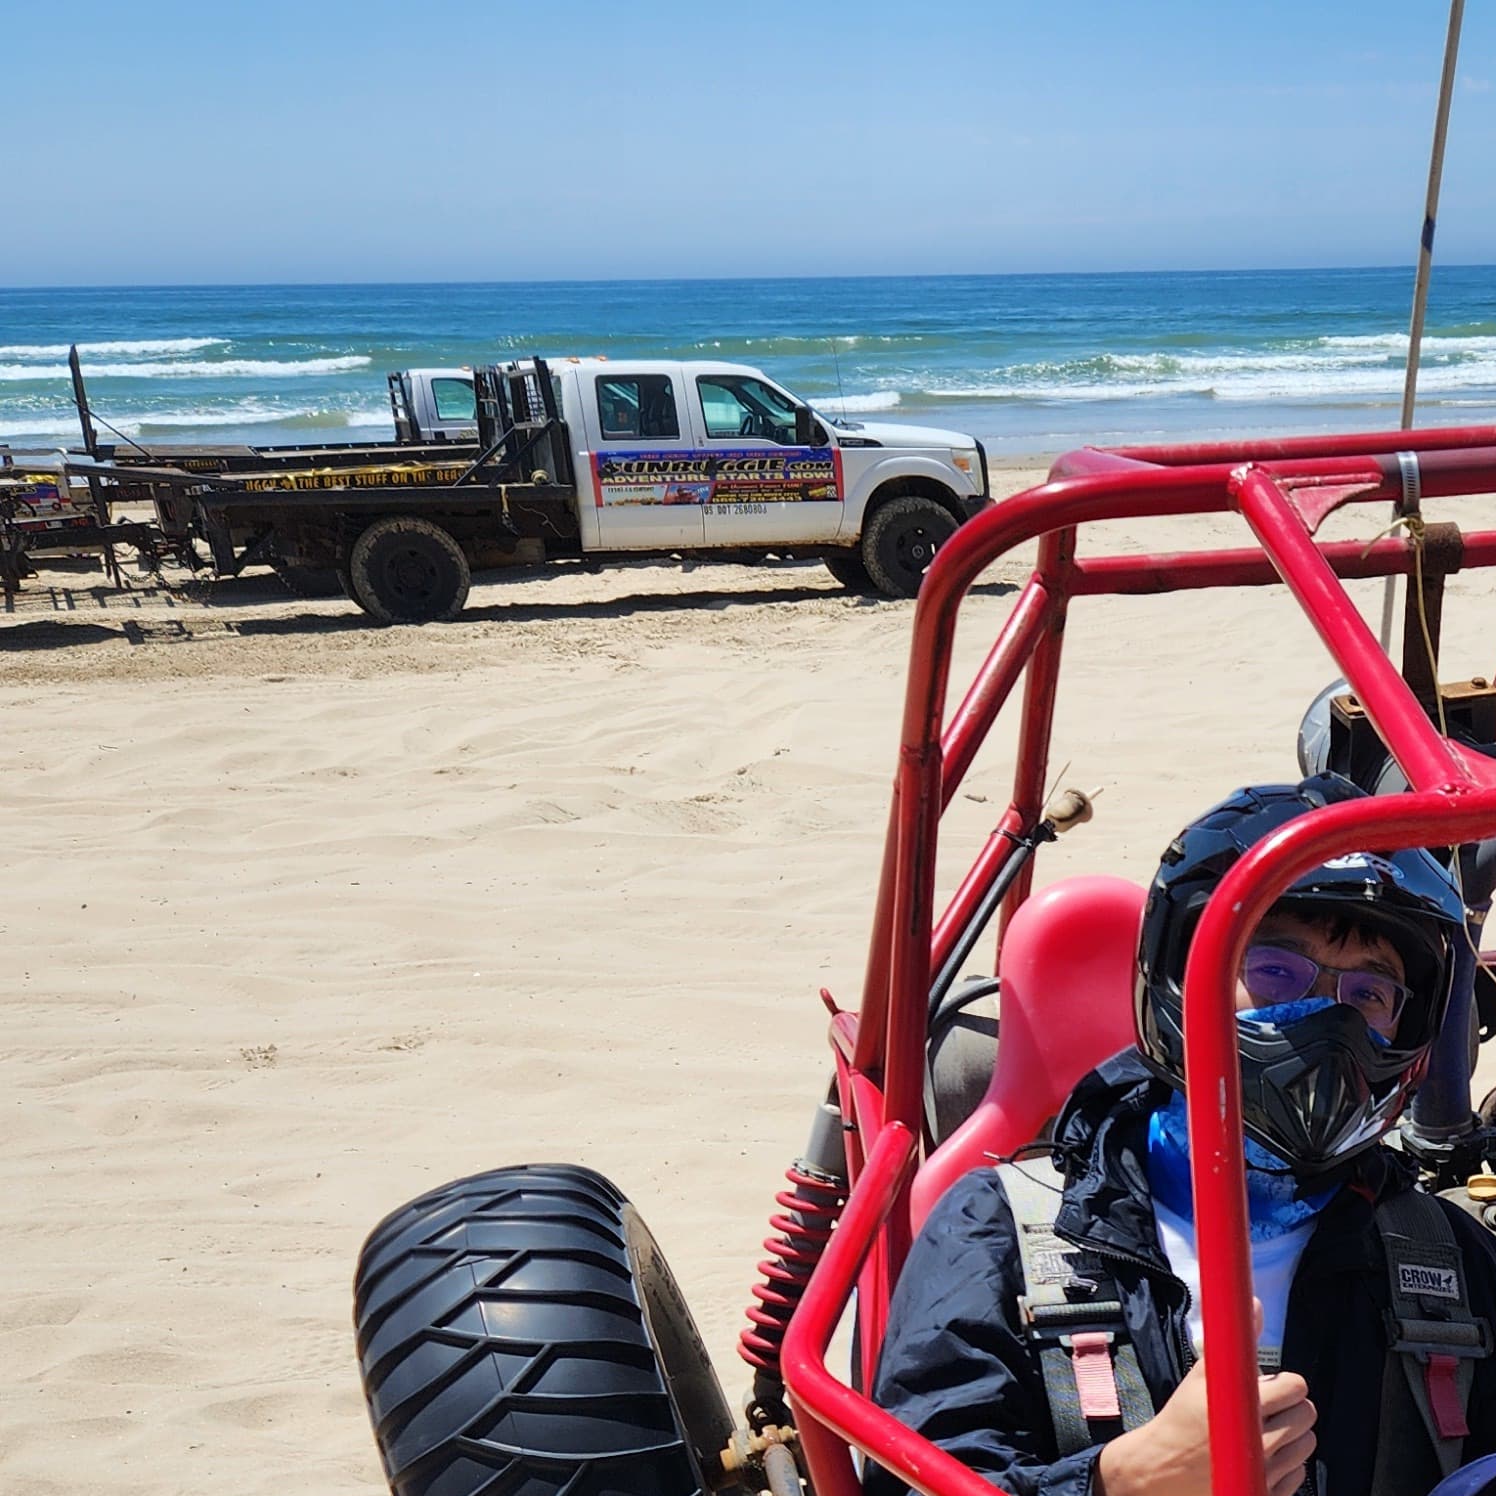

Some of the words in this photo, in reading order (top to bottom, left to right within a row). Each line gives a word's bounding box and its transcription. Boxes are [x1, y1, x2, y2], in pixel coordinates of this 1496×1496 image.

[298, 477, 320, 489] THE
[323, 475, 351, 488] BEST
[355, 472, 388, 487] STUFF
[601, 473, 711, 484] ADVENTURE
[715, 472, 784, 481] STARTS
[1400, 1268, 1442, 1287] CROW
